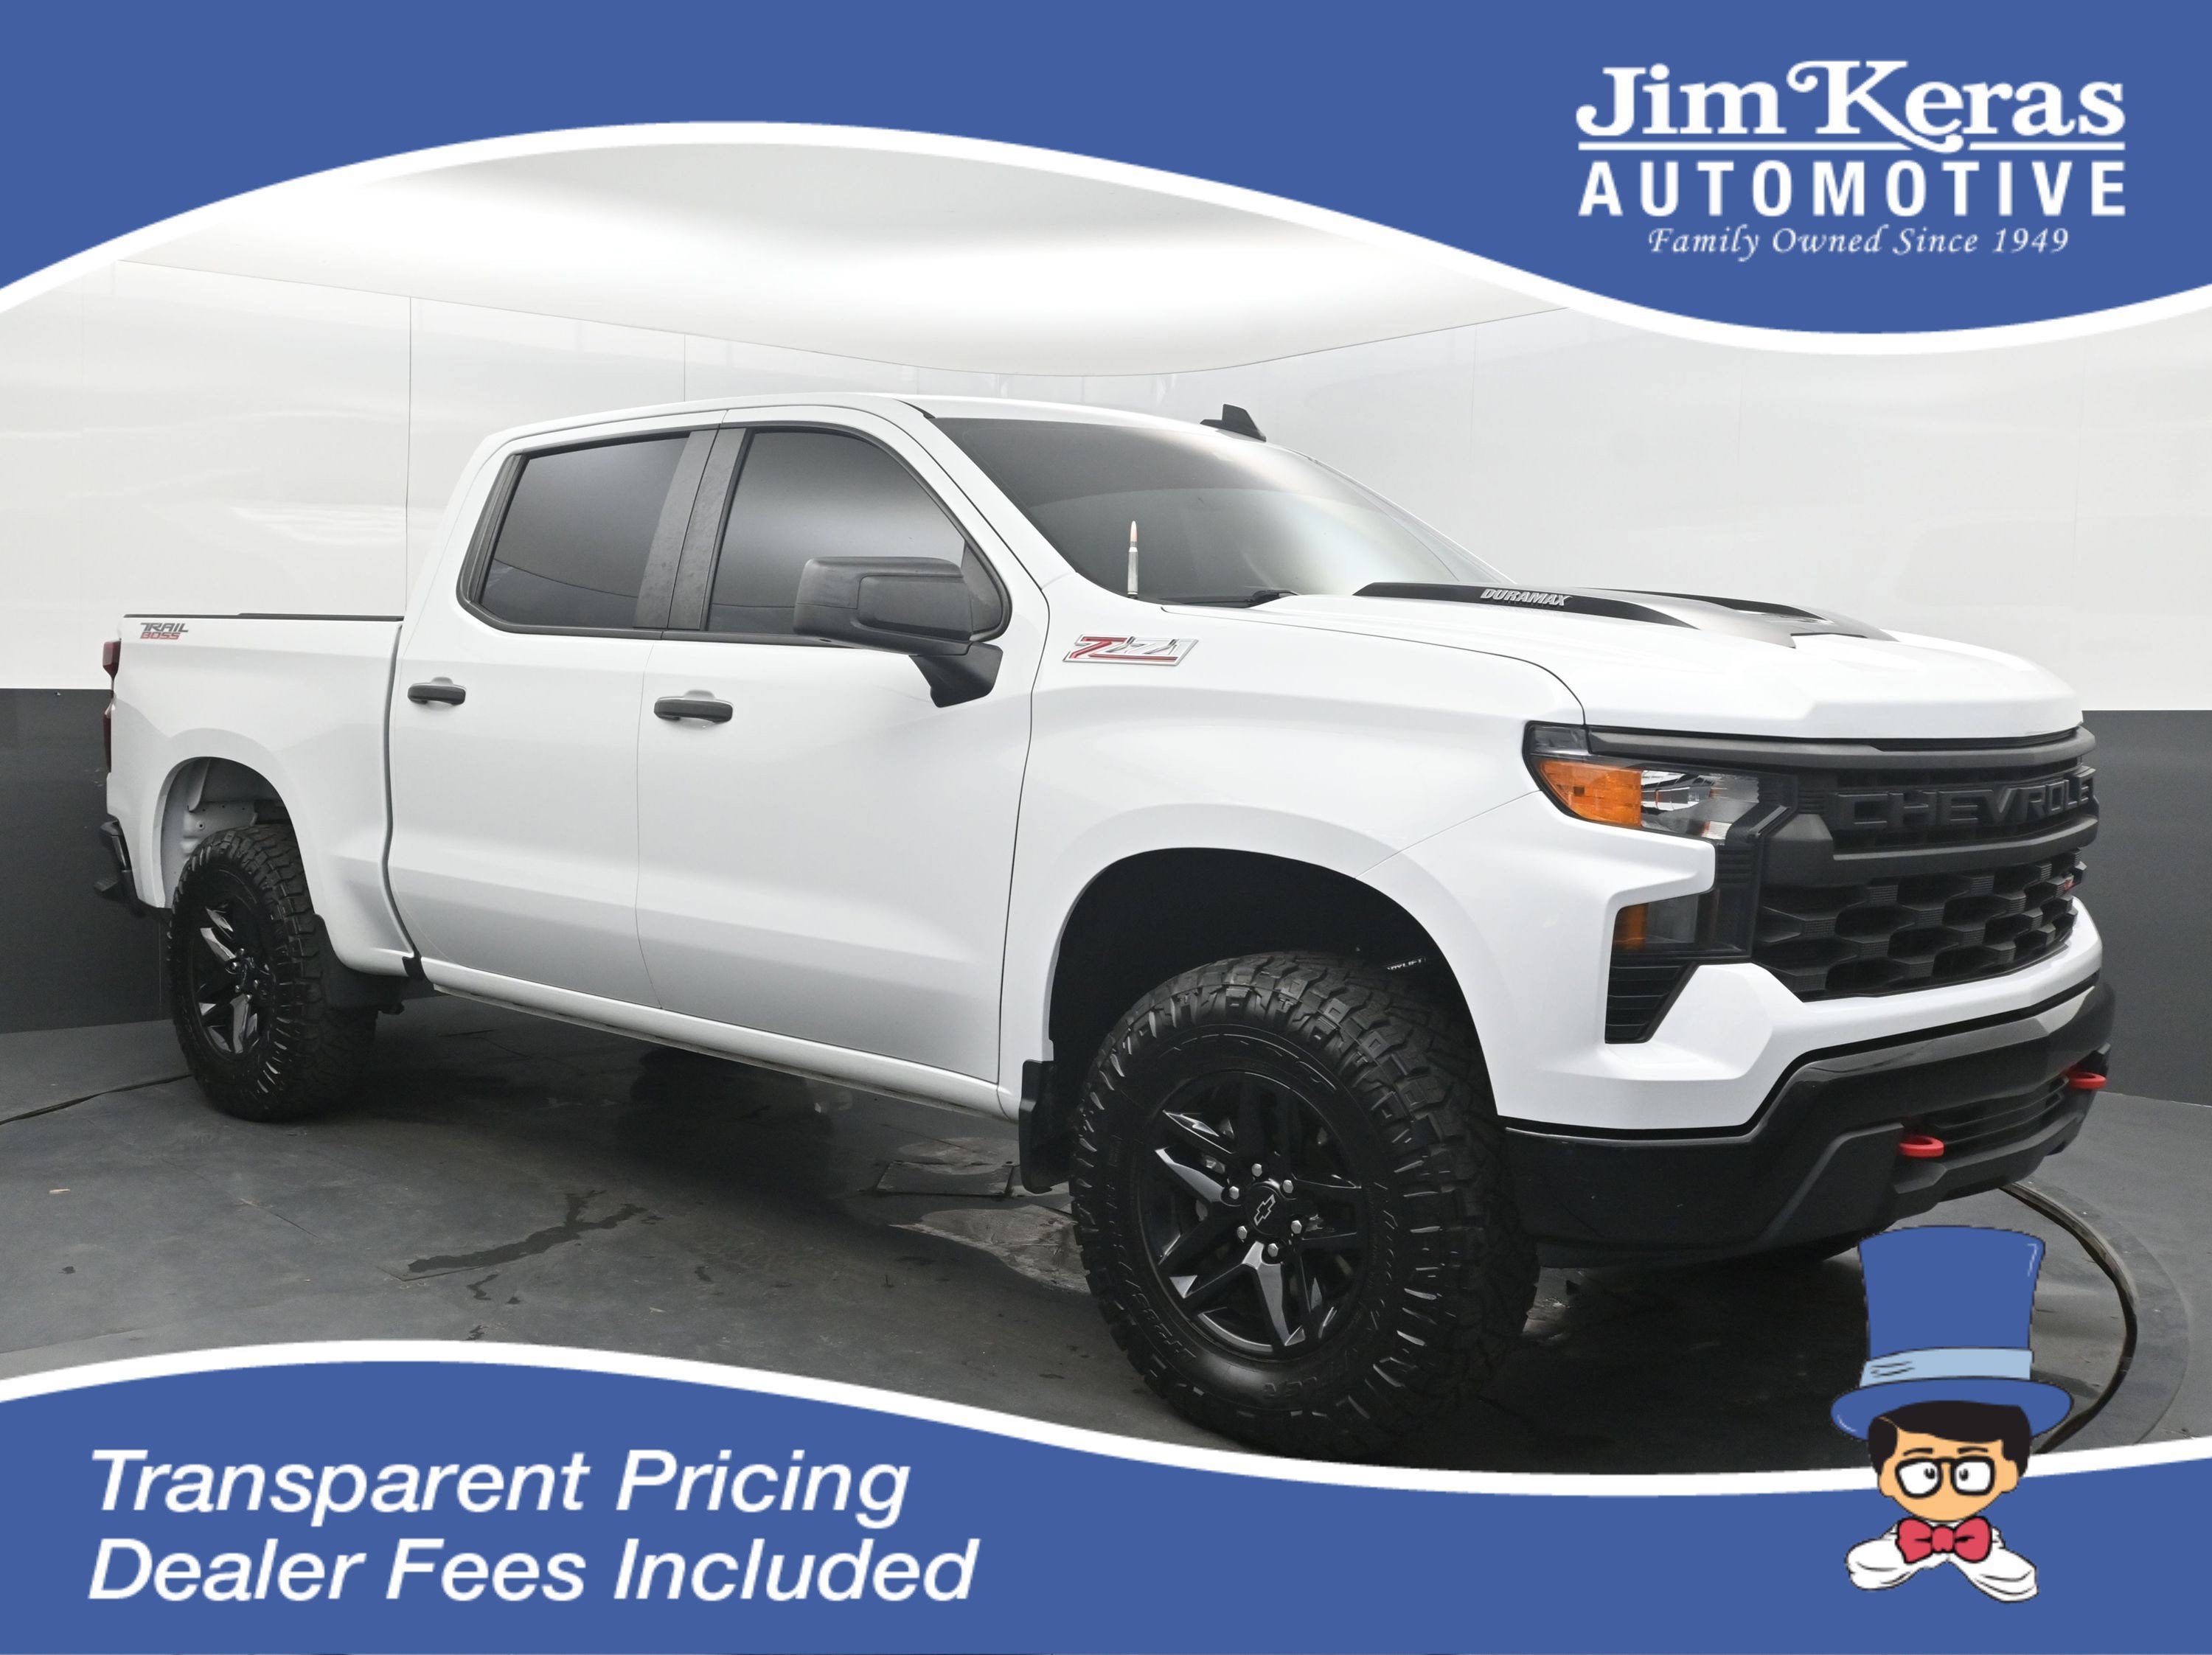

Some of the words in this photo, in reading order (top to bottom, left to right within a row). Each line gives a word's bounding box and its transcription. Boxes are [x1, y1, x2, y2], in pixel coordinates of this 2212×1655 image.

[1480, 588, 1573, 607] DURAMAX
[140, 622, 189, 633] TRAIL
[140, 632, 181, 640] BOSS
[1062, 634, 1200, 666] Z71
